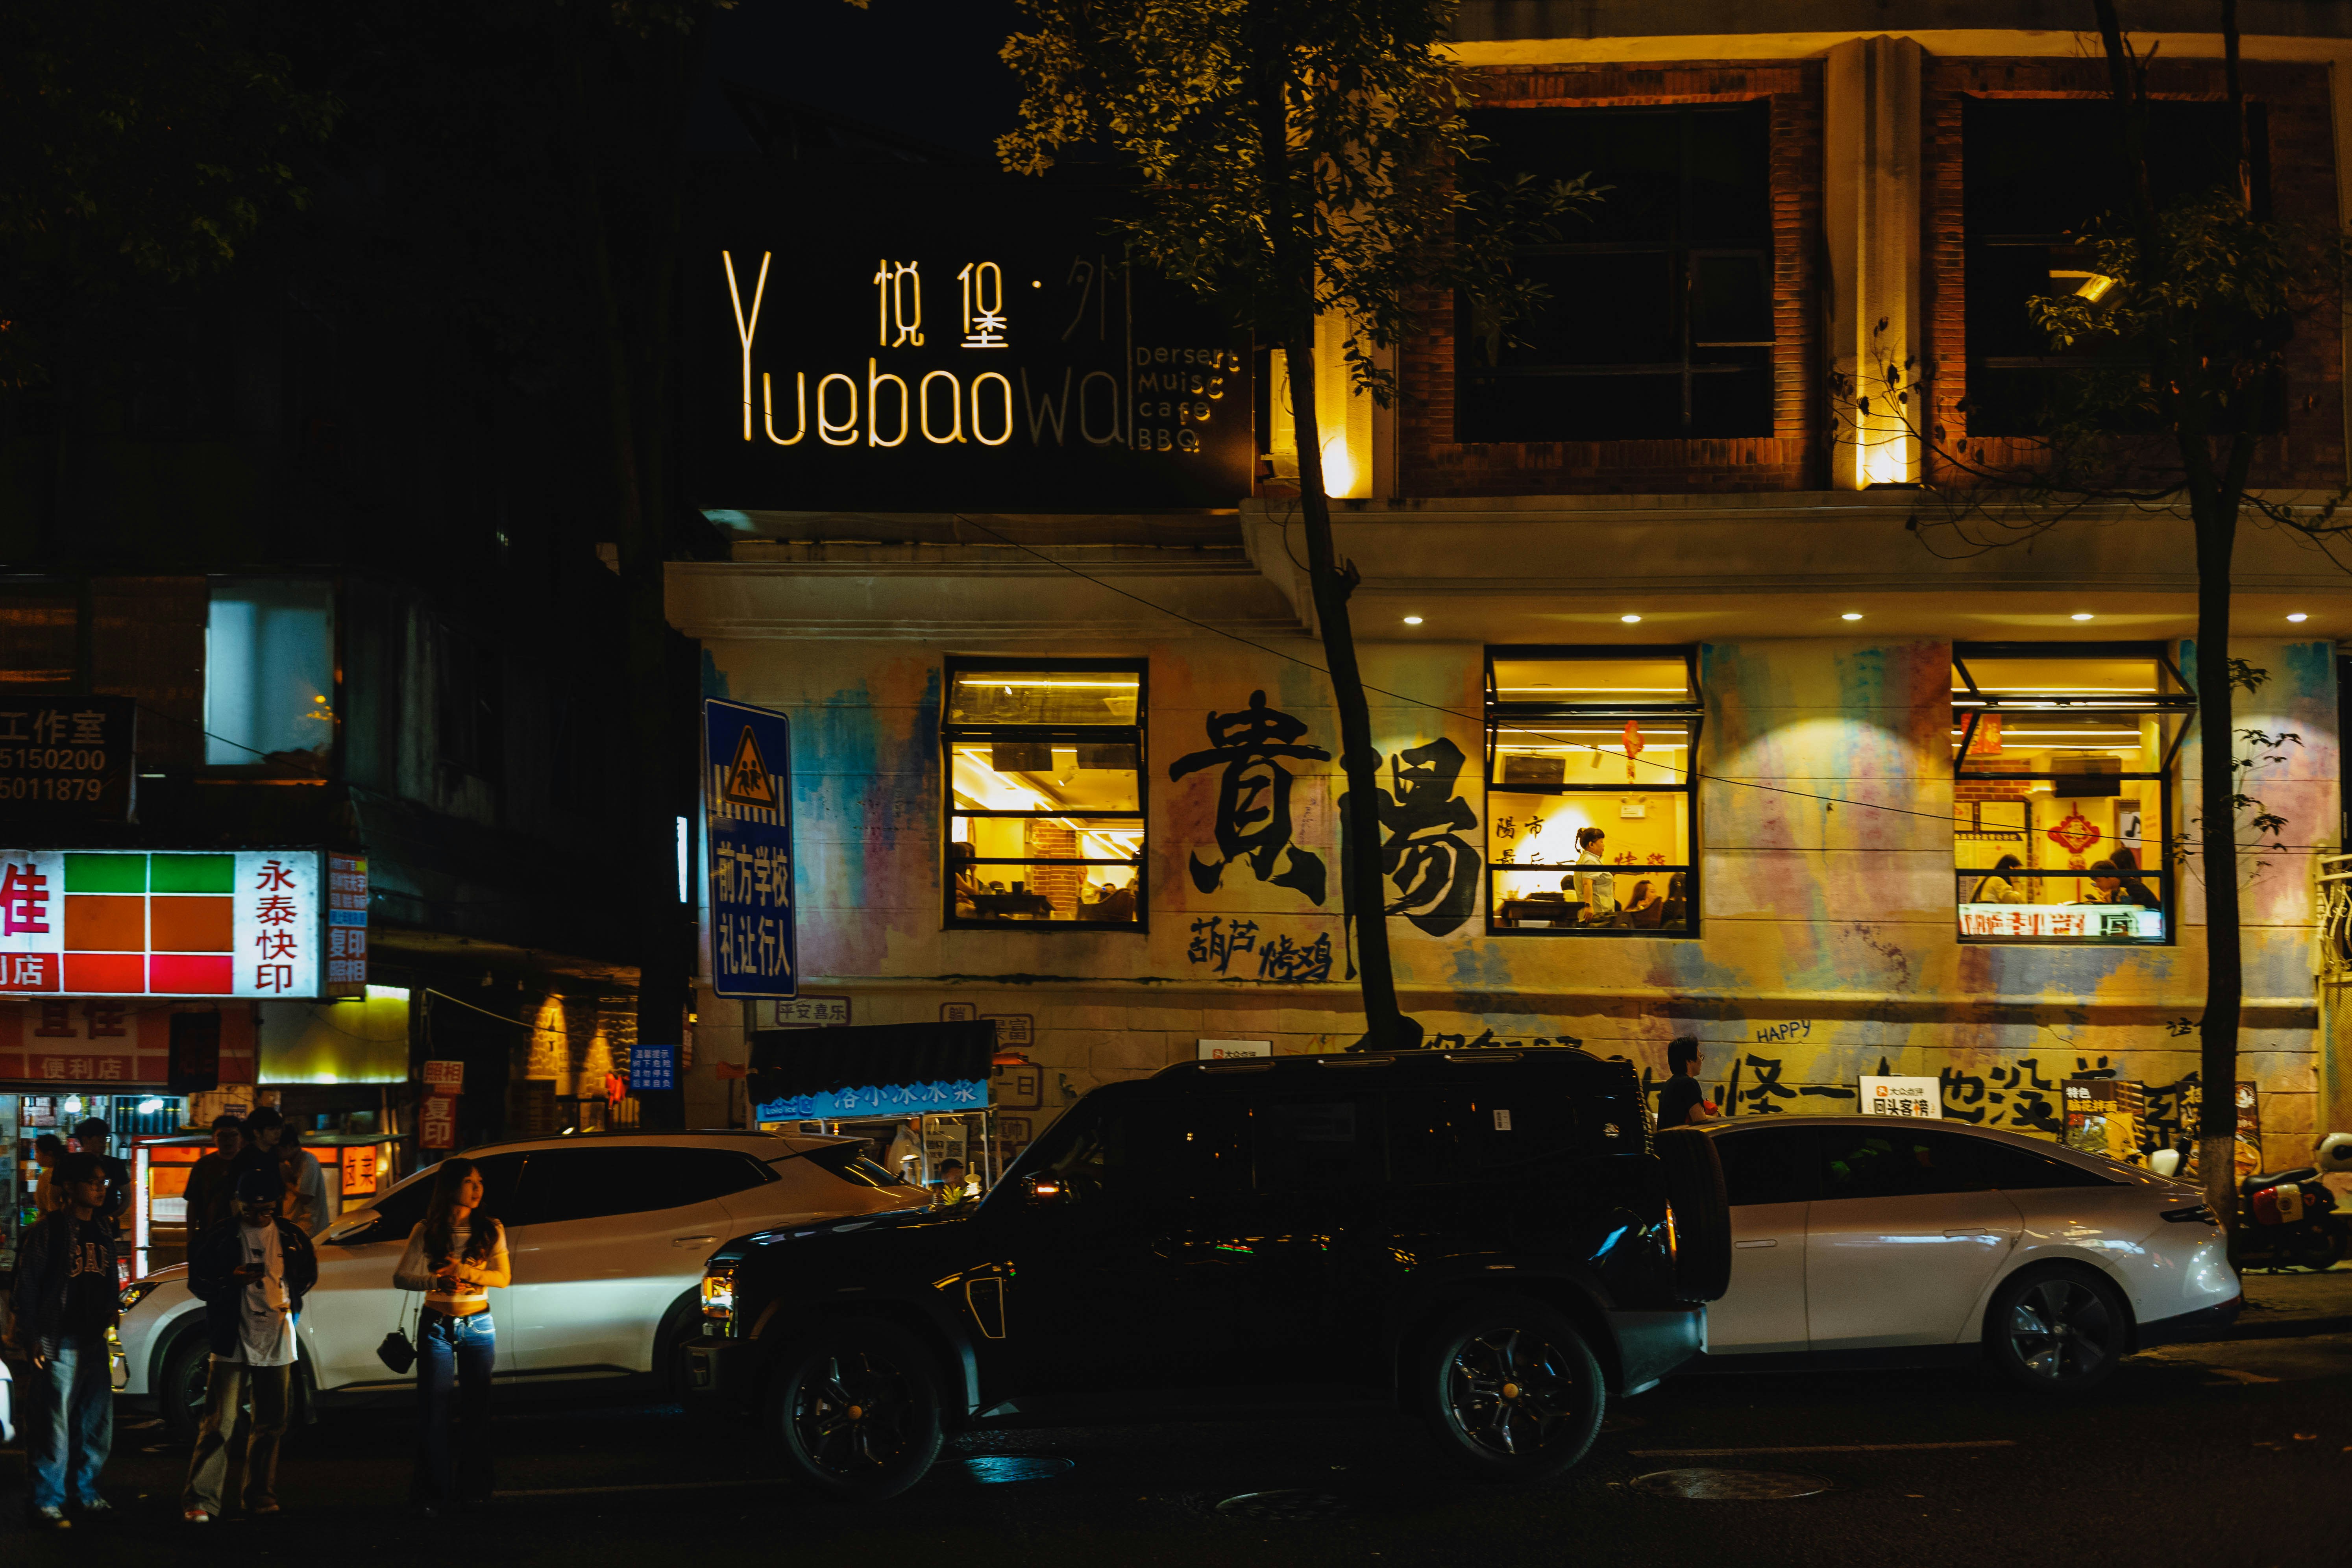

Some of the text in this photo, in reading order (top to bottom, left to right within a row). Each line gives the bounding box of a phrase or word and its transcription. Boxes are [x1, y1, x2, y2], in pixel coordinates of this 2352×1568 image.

[1138, 428, 1200, 453] BBQ
[0, 709, 107, 744] 工作室
[0, 749, 106, 770] 5150200
[0, 777, 103, 801] 5011879
[716, 841, 789, 908] 前方学校
[255, 860, 297, 994] 永泰快印
[719, 912, 791, 977] 礼让行人
[780, 1003, 847, 1021] 平安喜乐
[1757, 1019, 1811, 1043] HAPPY
[41, 1058, 123, 1080] 便利店
[1889, 1087, 1924, 1096] 大众点评
